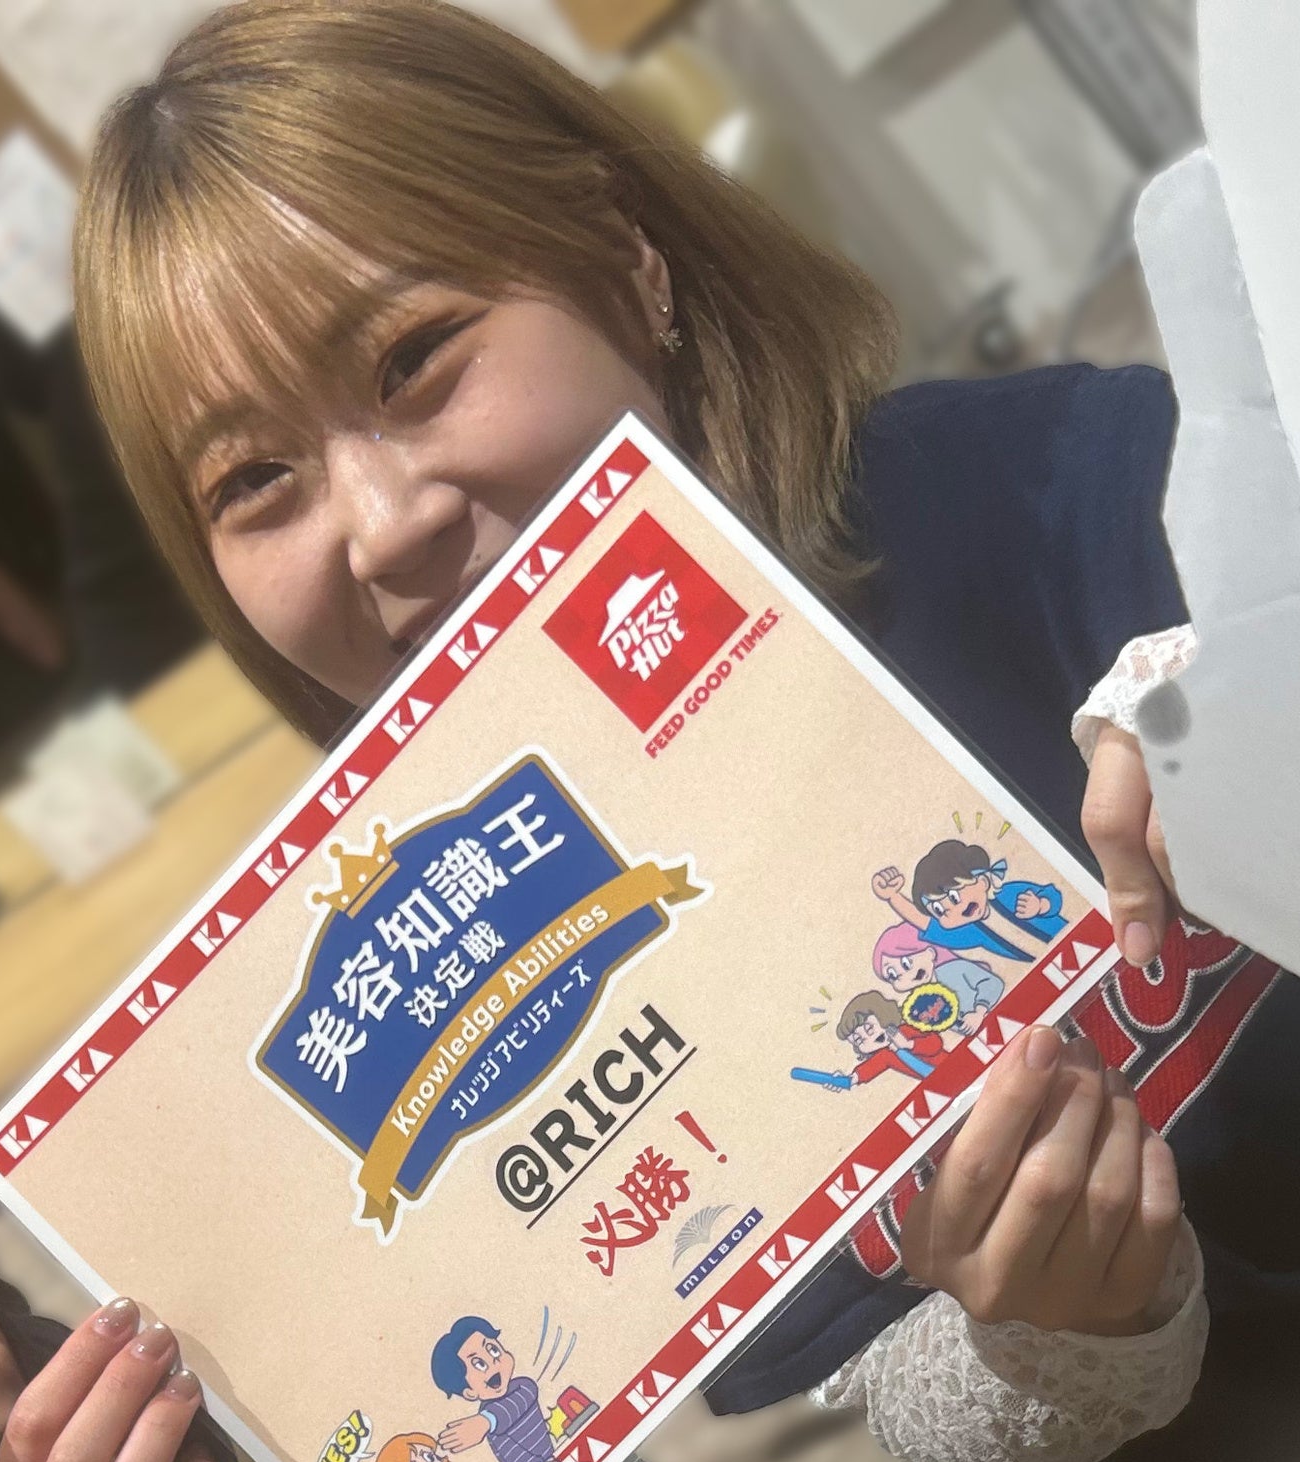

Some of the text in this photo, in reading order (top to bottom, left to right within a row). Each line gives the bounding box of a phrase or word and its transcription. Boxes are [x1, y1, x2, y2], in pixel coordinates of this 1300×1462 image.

[606, 580, 680, 670] Pizza
[628, 617, 686, 682] Hut
[644, 608, 781, 759] FEED GOOD TIMES
[0, 468, 633, 1160] KA KA KA KA KA KA KA KA KA KA
[296, 792, 566, 1094] 美容知識王
[390, 903, 610, 1138] Knowledge Abilities
[404, 919, 508, 1030] 決定戦
[495, 1003, 687, 1213] @RICH
[626, 1369, 677, 1415] KA
[690, 1302, 743, 1349] KA
[757, 1232, 810, 1281] KA
[825, 1161, 879, 1210] KA
[894, 1089, 952, 1138] KA
[967, 1016, 1026, 1065] KA
[1042, 941, 1101, 990] KA
